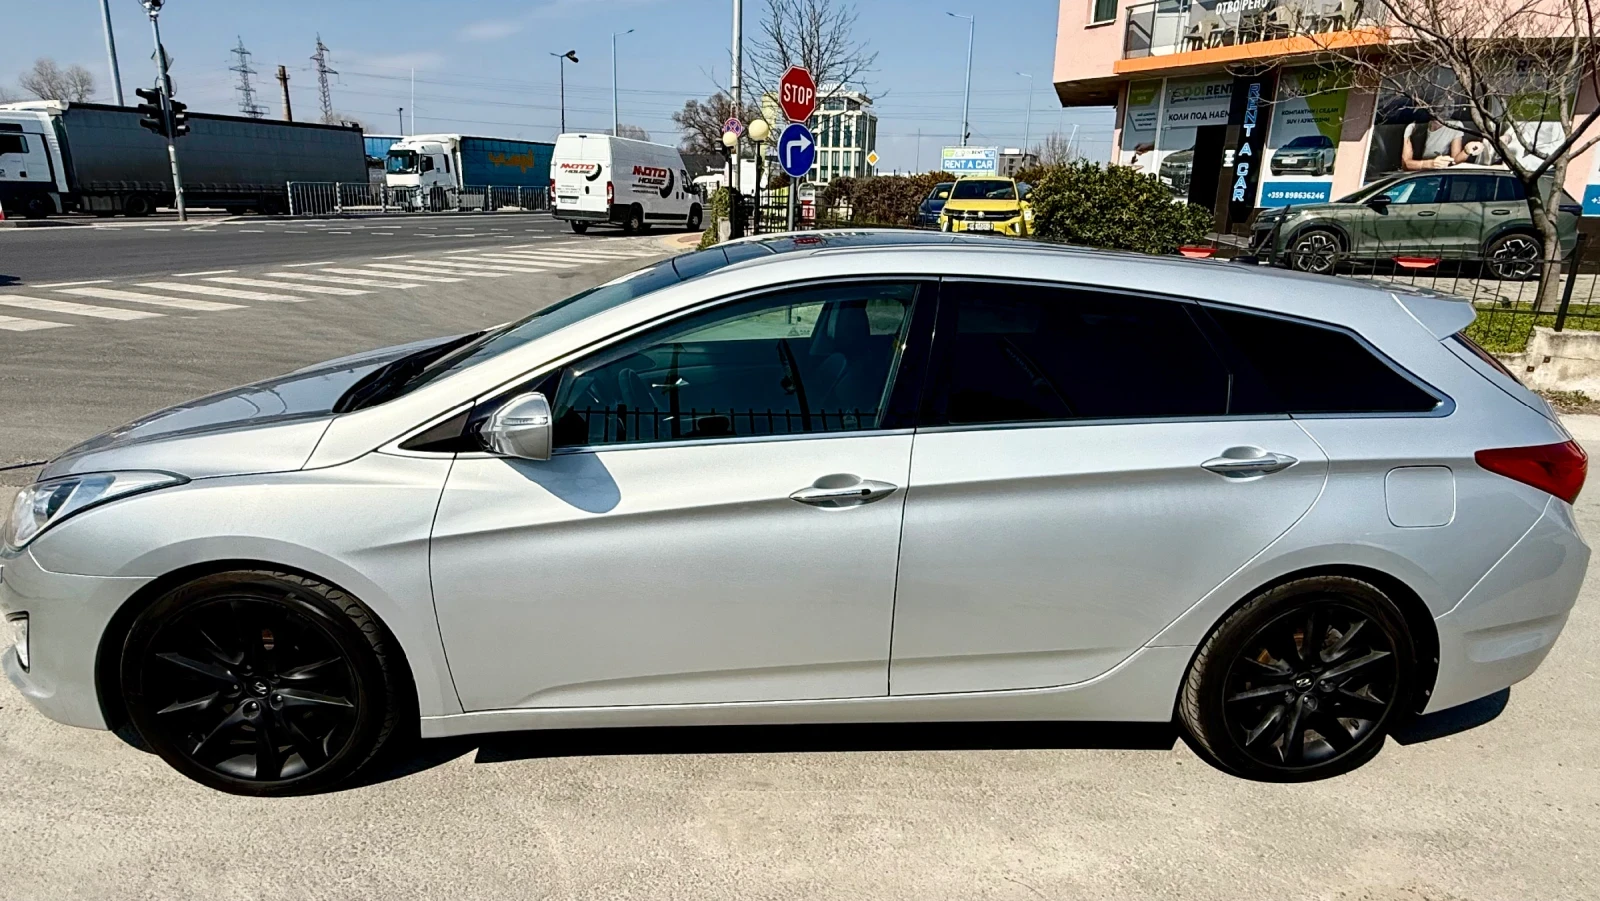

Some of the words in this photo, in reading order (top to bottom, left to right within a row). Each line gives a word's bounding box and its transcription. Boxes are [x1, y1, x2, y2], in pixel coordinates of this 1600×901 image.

[783, 83, 813, 105] STOP
[1168, 113, 1189, 121] КОЛИ
[1190, 111, 1208, 120] ПОД
[1244, 83, 1260, 137] RENT
[1238, 142, 1252, 156] A
[944, 160, 966, 169] RENT
[967, 160, 974, 169] A
[975, 160, 993, 169] CAR
[632, 165, 667, 178] MOTO
[637, 176, 666, 185] HOUSE
[1232, 163, 1249, 202] CAR
[1284, 191, 1325, 199] 898636246
